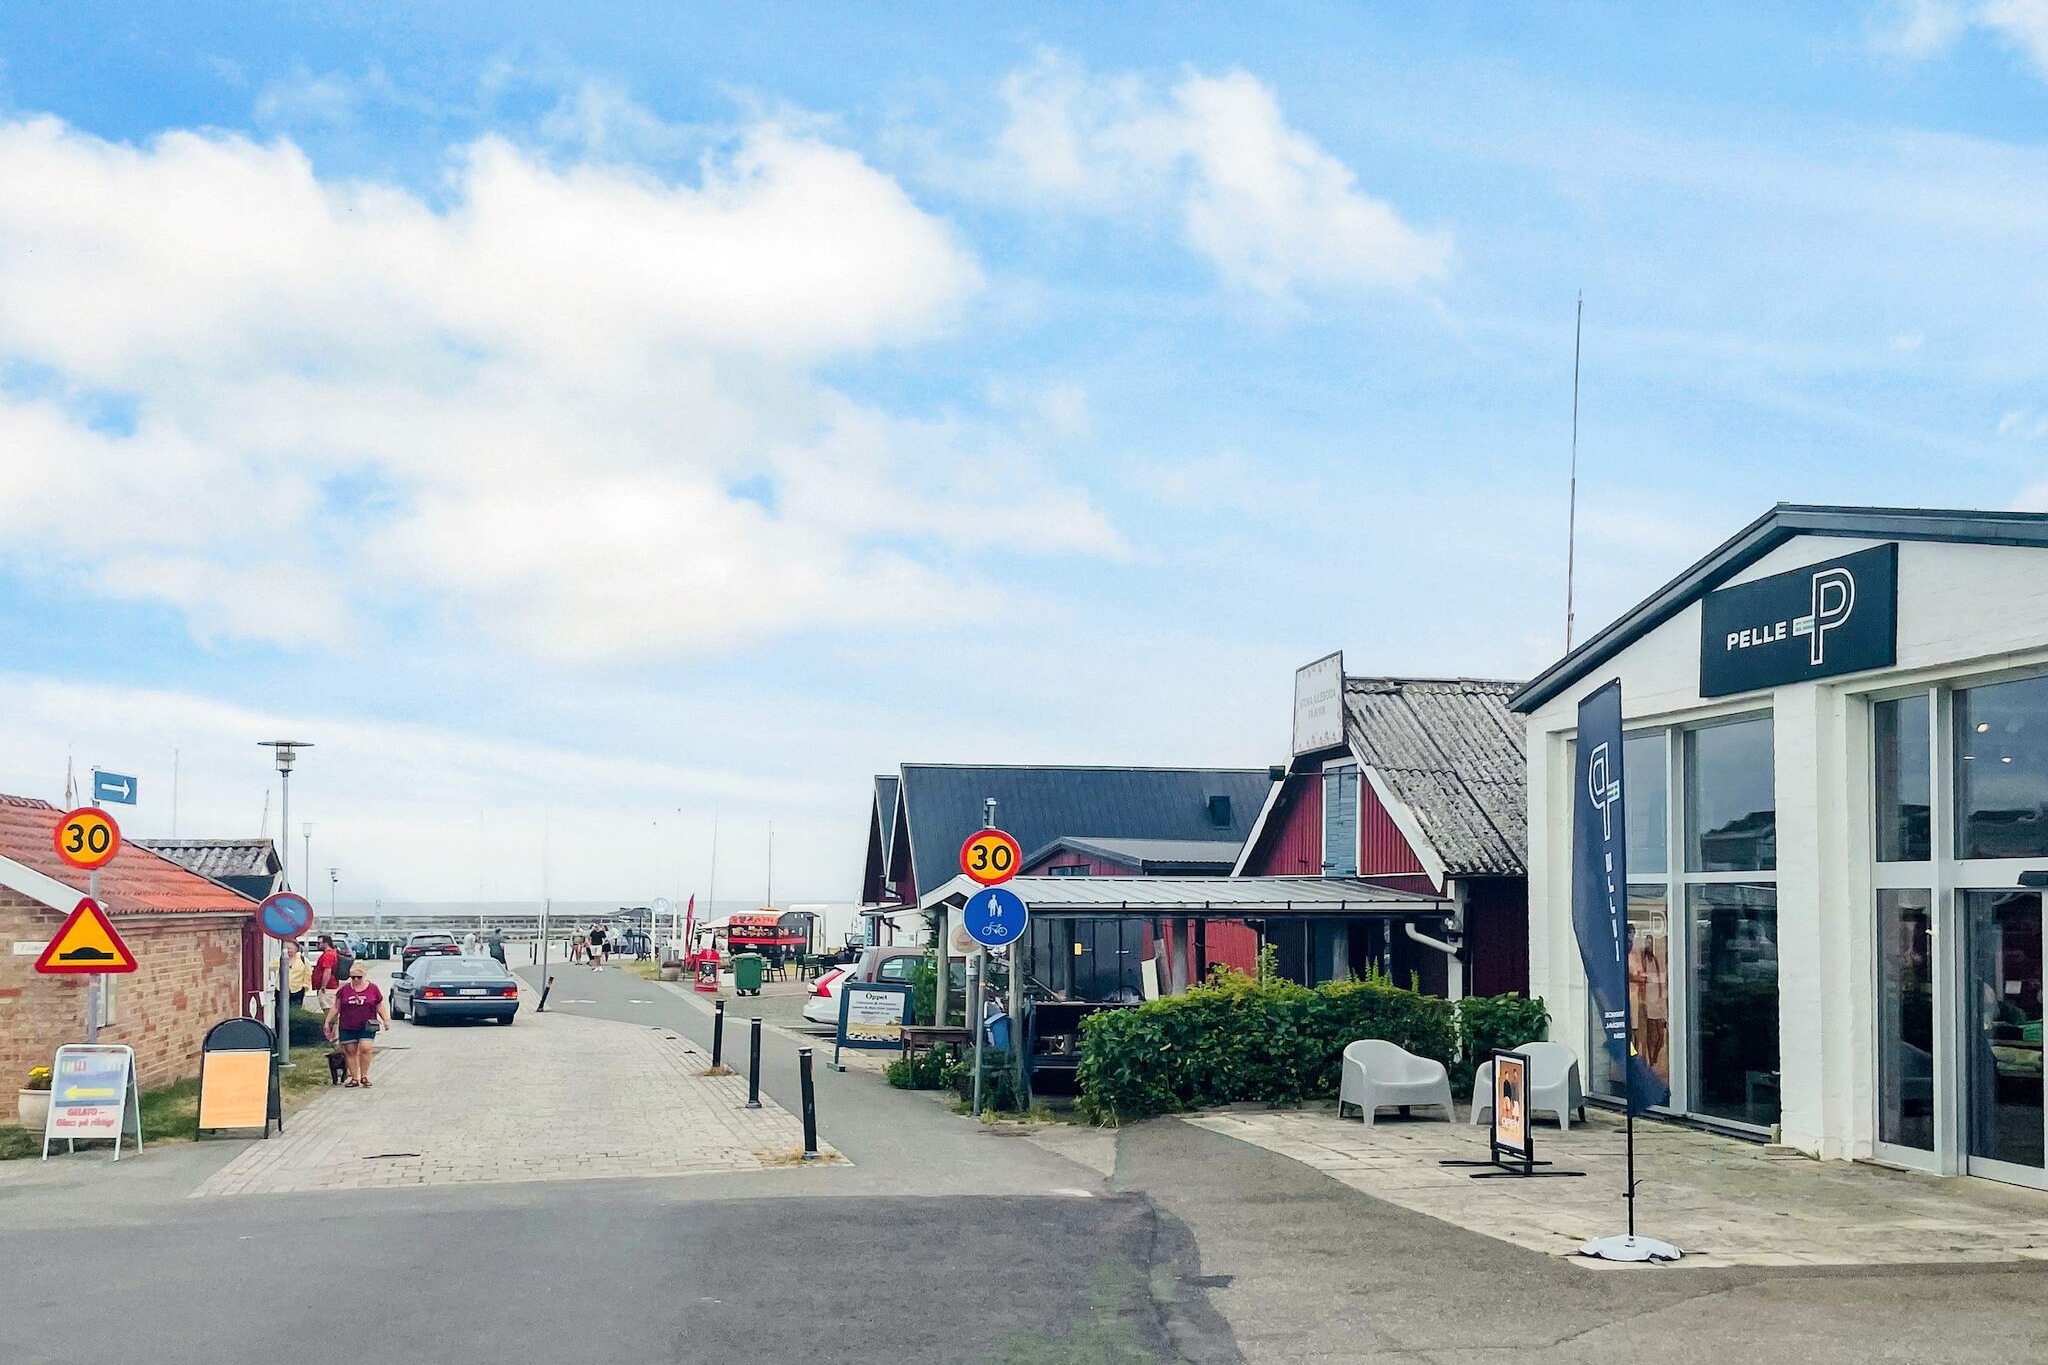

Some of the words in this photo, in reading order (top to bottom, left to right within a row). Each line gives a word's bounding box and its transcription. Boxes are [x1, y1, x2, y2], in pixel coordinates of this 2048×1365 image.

[1726, 621, 1787, 652] PELLE
[1810, 567, 1856, 666] P
[66, 823, 110, 853] 30
[971, 844, 1012, 871] 30
